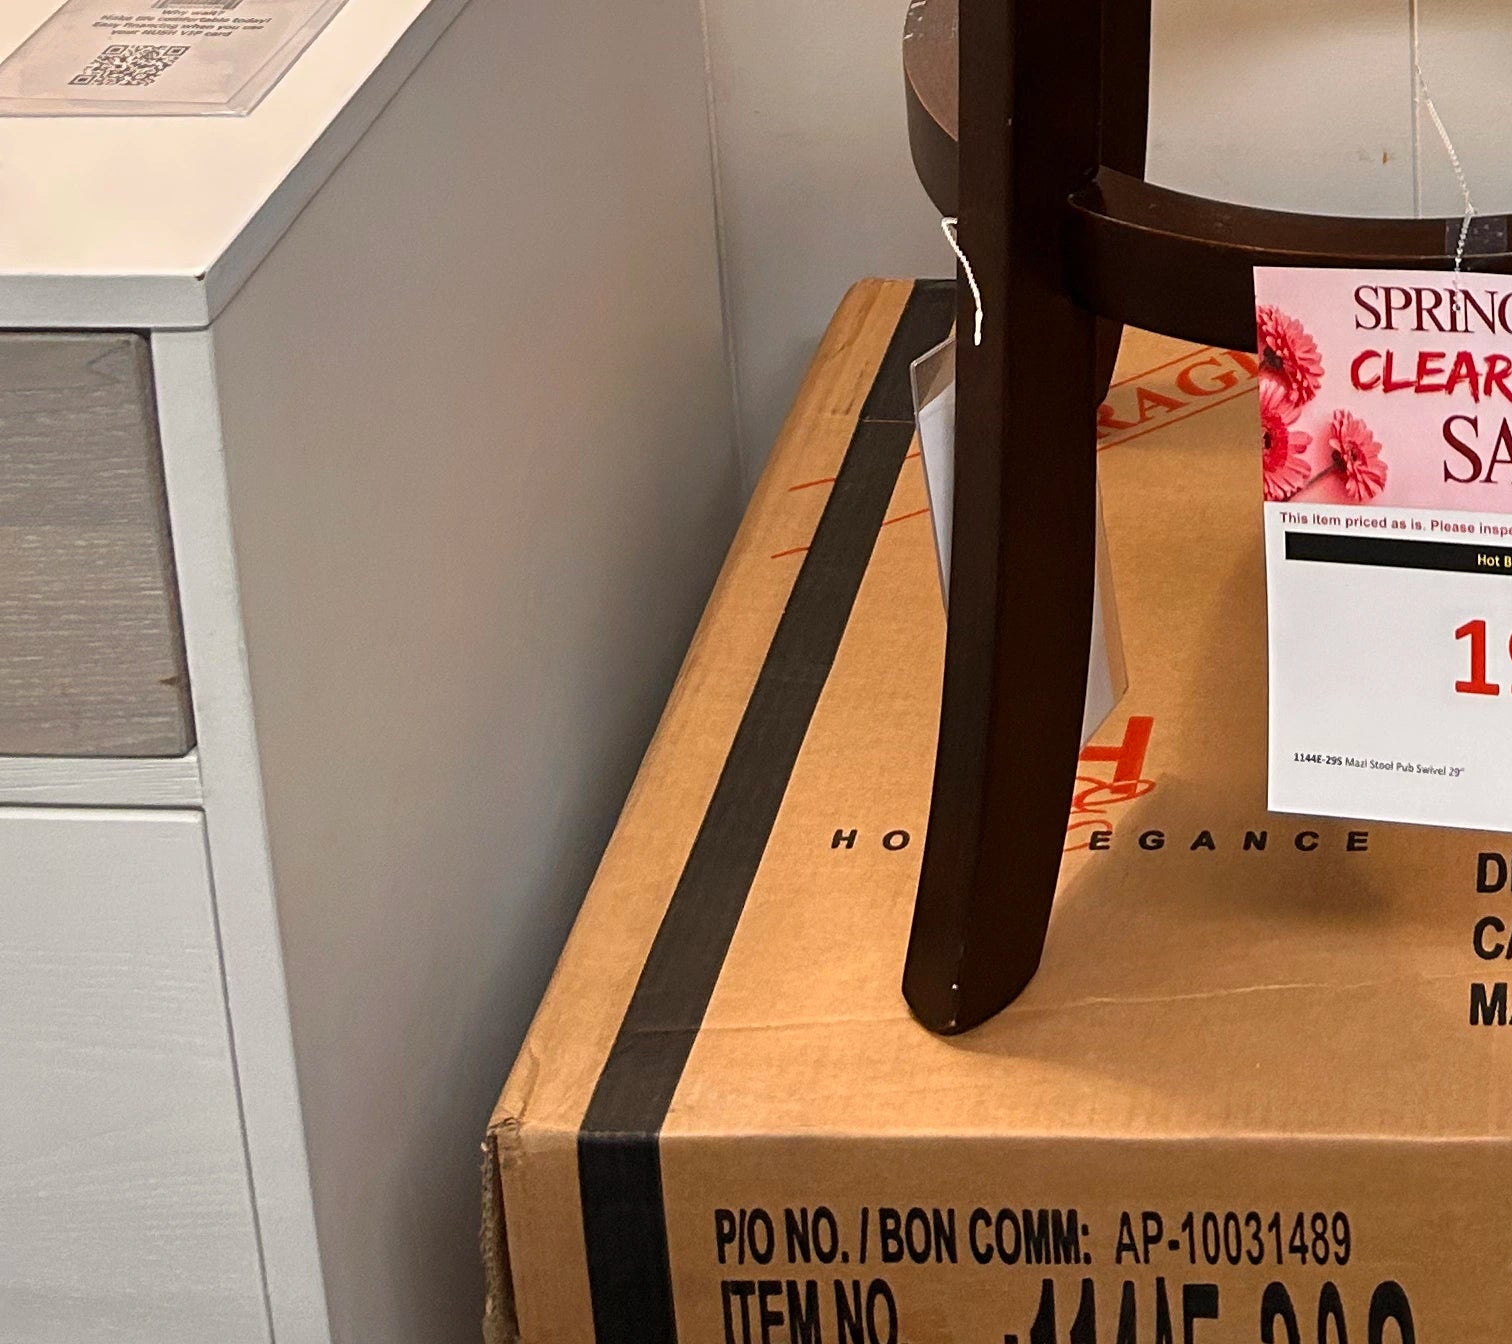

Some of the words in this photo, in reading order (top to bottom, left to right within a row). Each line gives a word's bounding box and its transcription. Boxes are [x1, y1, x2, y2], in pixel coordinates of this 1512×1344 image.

[1280, 512, 1308, 525] This
[1312, 514, 1341, 527] item
[1345, 516, 1387, 531] priced
[1391, 520, 1407, 529] as
[1410, 520, 1426, 531] is.
[1430, 520, 1475, 534] Please
[1477, 553, 1500, 568] Hot
[1370, 760, 1393, 770] Stool
[1396, 762, 1414, 772] Pub
[1417, 764, 1446, 775] Swivel
[714, 1207, 776, 1265] P/O
[783, 1206, 850, 1265] NO.
[880, 1207, 959, 1265] BON
[967, 1208, 1092, 1265] COMM:
[1115, 1210, 1351, 1266] AP-10031489
